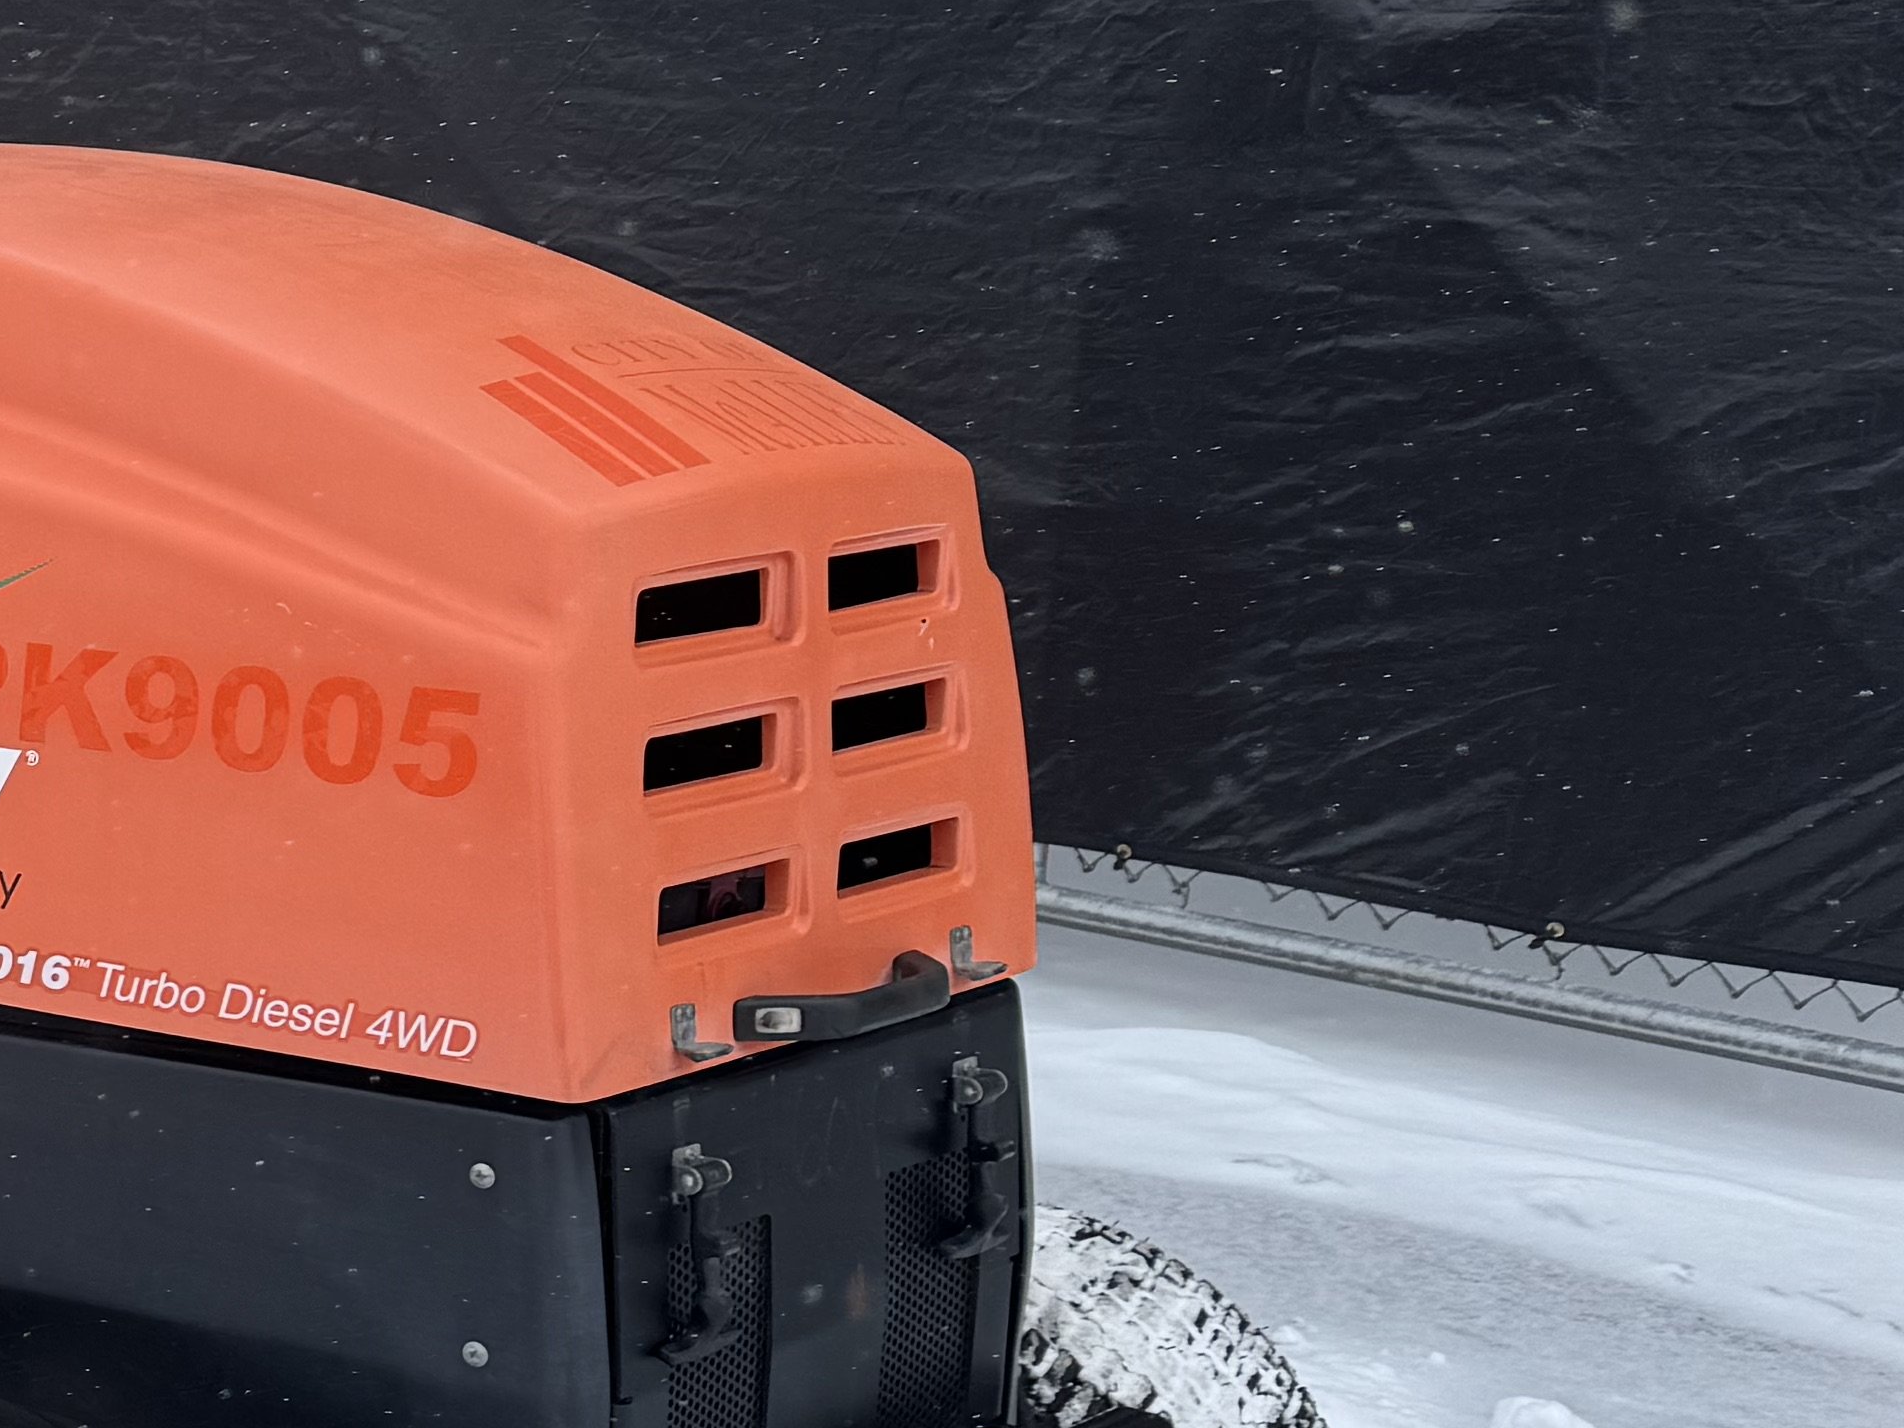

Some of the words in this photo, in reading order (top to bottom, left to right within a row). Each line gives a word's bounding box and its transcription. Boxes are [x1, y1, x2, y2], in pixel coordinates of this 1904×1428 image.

[570, 339, 698, 367] CITY
[95, 961, 206, 1015] Turbo
[217, 982, 355, 1040] Diesel
[365, 1009, 479, 1061] 4WD
